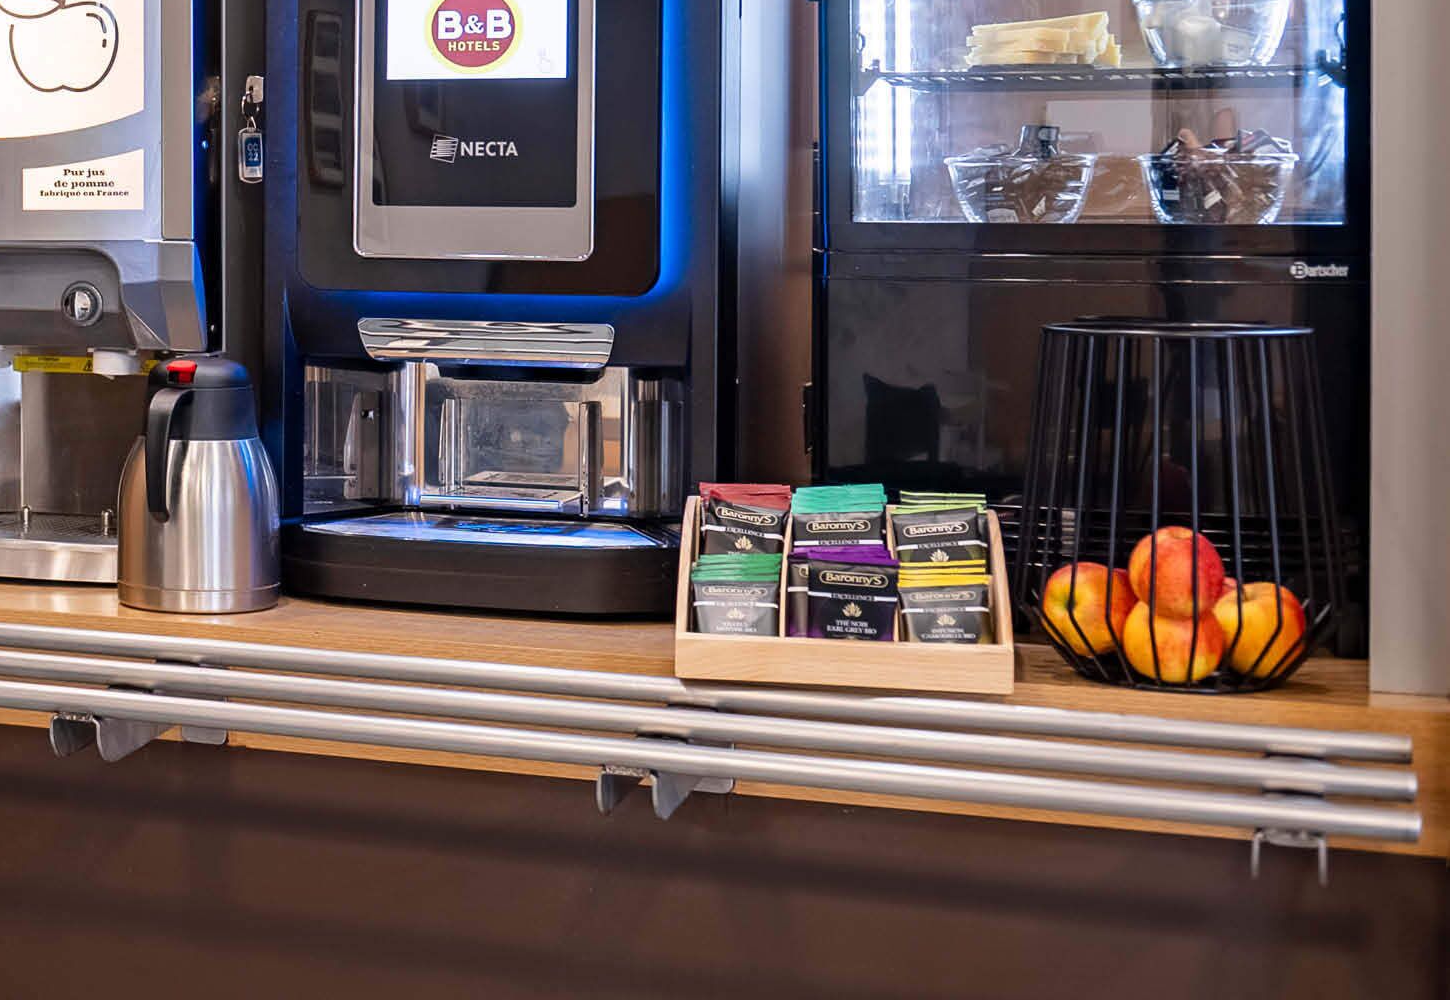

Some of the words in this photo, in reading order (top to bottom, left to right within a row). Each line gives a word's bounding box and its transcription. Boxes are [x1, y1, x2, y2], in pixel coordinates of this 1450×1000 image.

[437, 9, 512, 40] B&B
[448, 40, 500, 52] HOTELS
[460, 141, 518, 157] NECTA
[63, 168, 85, 176] Pur
[86, 168, 105, 178] jus
[54, 180, 68, 188] de
[71, 180, 115, 190] pomme
